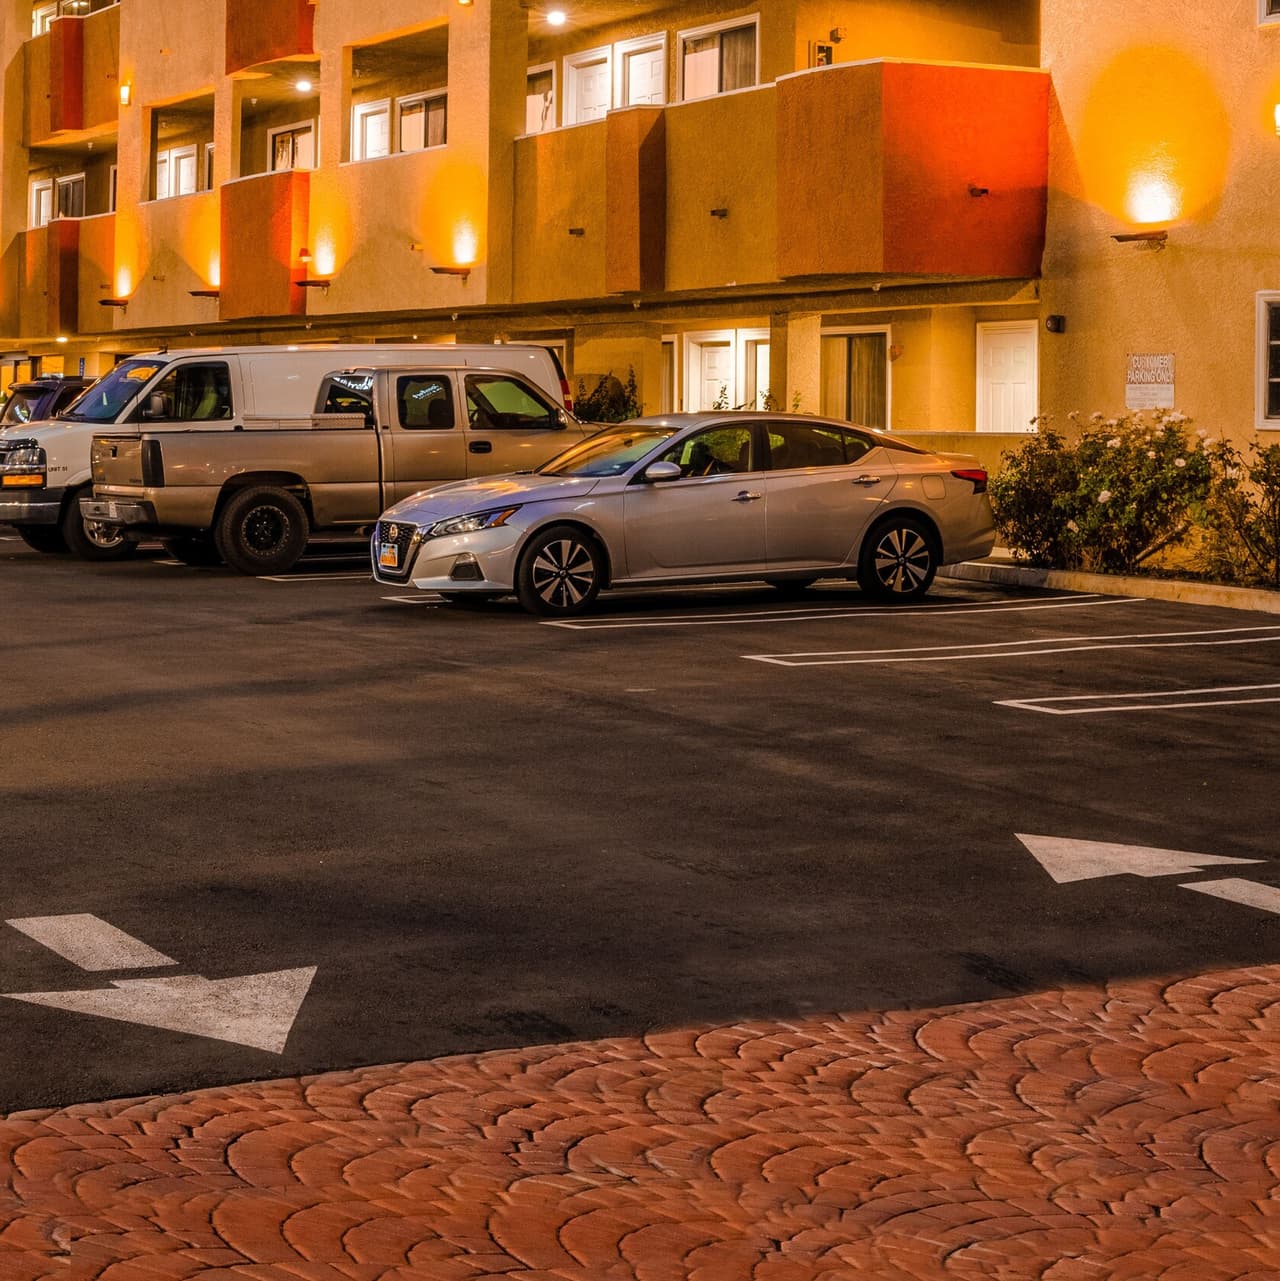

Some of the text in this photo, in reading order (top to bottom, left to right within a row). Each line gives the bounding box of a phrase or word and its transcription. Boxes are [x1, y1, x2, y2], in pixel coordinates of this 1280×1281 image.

[1132, 356, 1169, 368] CUSTOMER
[1128, 370, 1173, 383] PARKING ONLY
